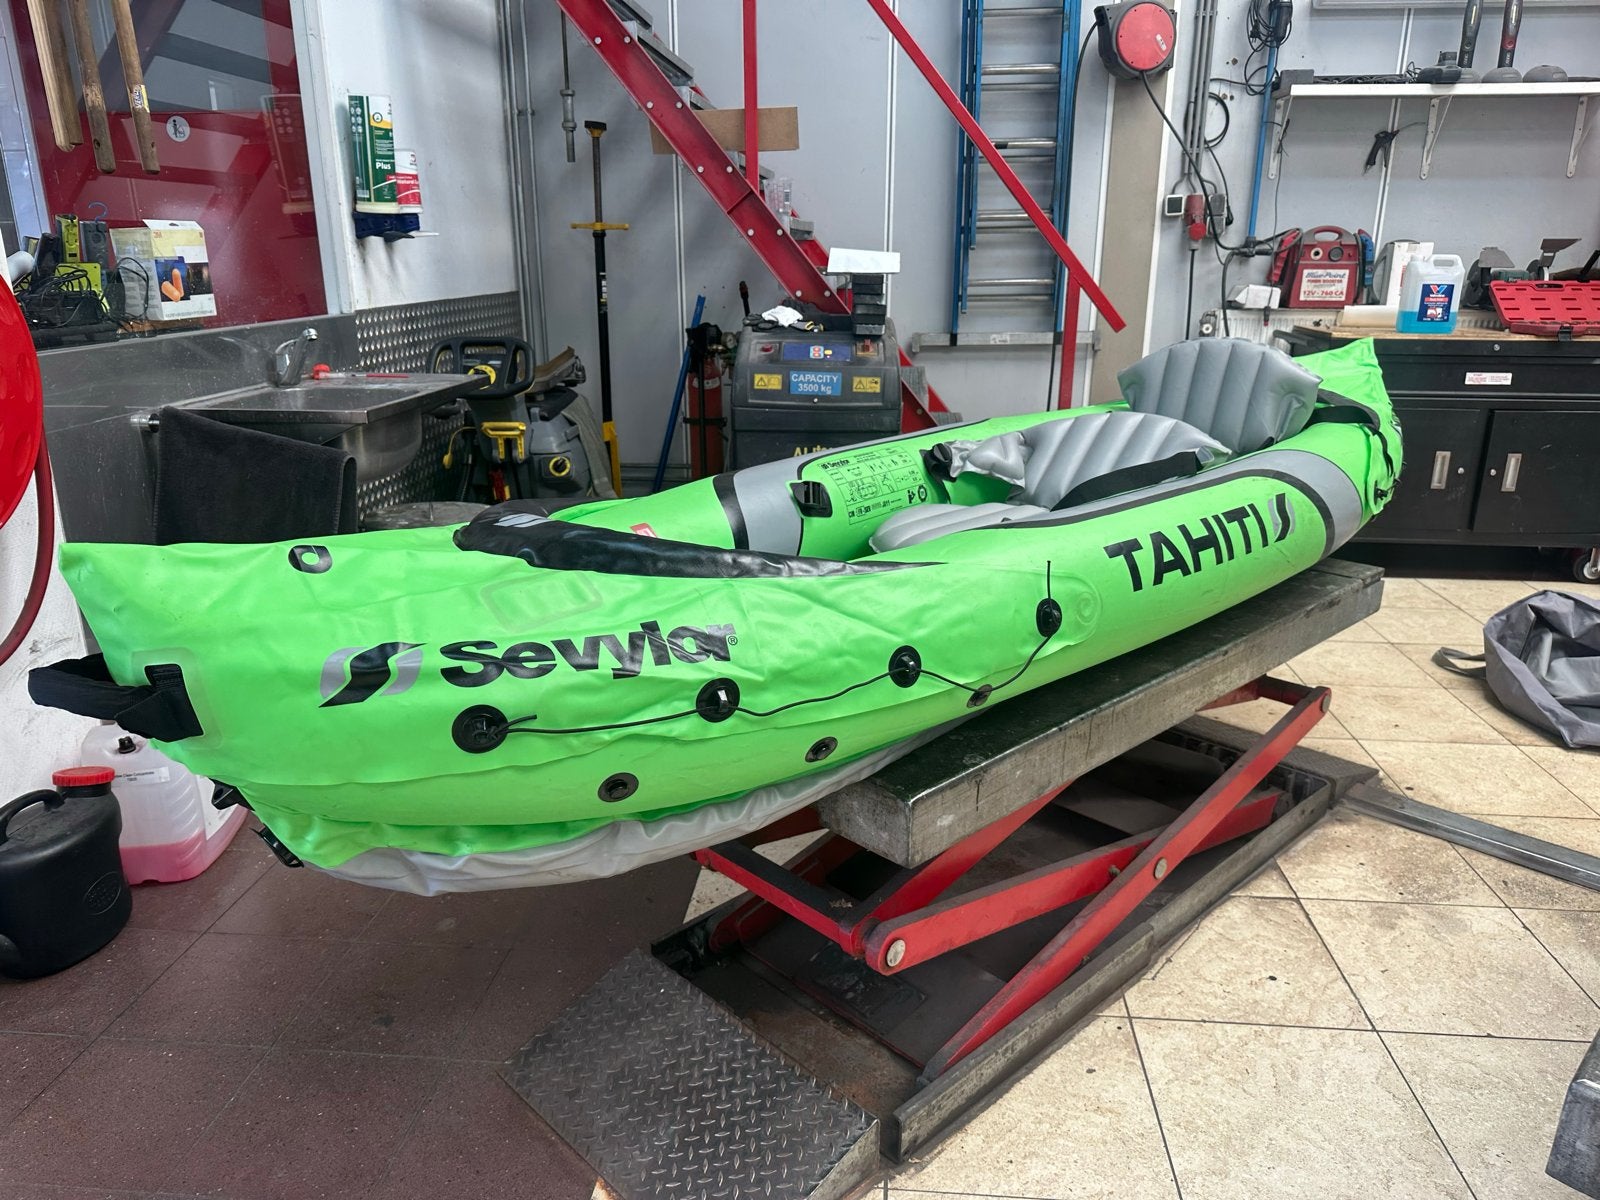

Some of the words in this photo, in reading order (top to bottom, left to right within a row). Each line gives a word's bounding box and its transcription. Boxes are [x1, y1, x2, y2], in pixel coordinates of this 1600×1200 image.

[376, 162, 391, 170] Plus
[791, 373, 838, 383] CAPACITY
[798, 383, 819, 392] 3500
[820, 384, 832, 394] kg
[1103, 503, 1269, 592] TAHITI
